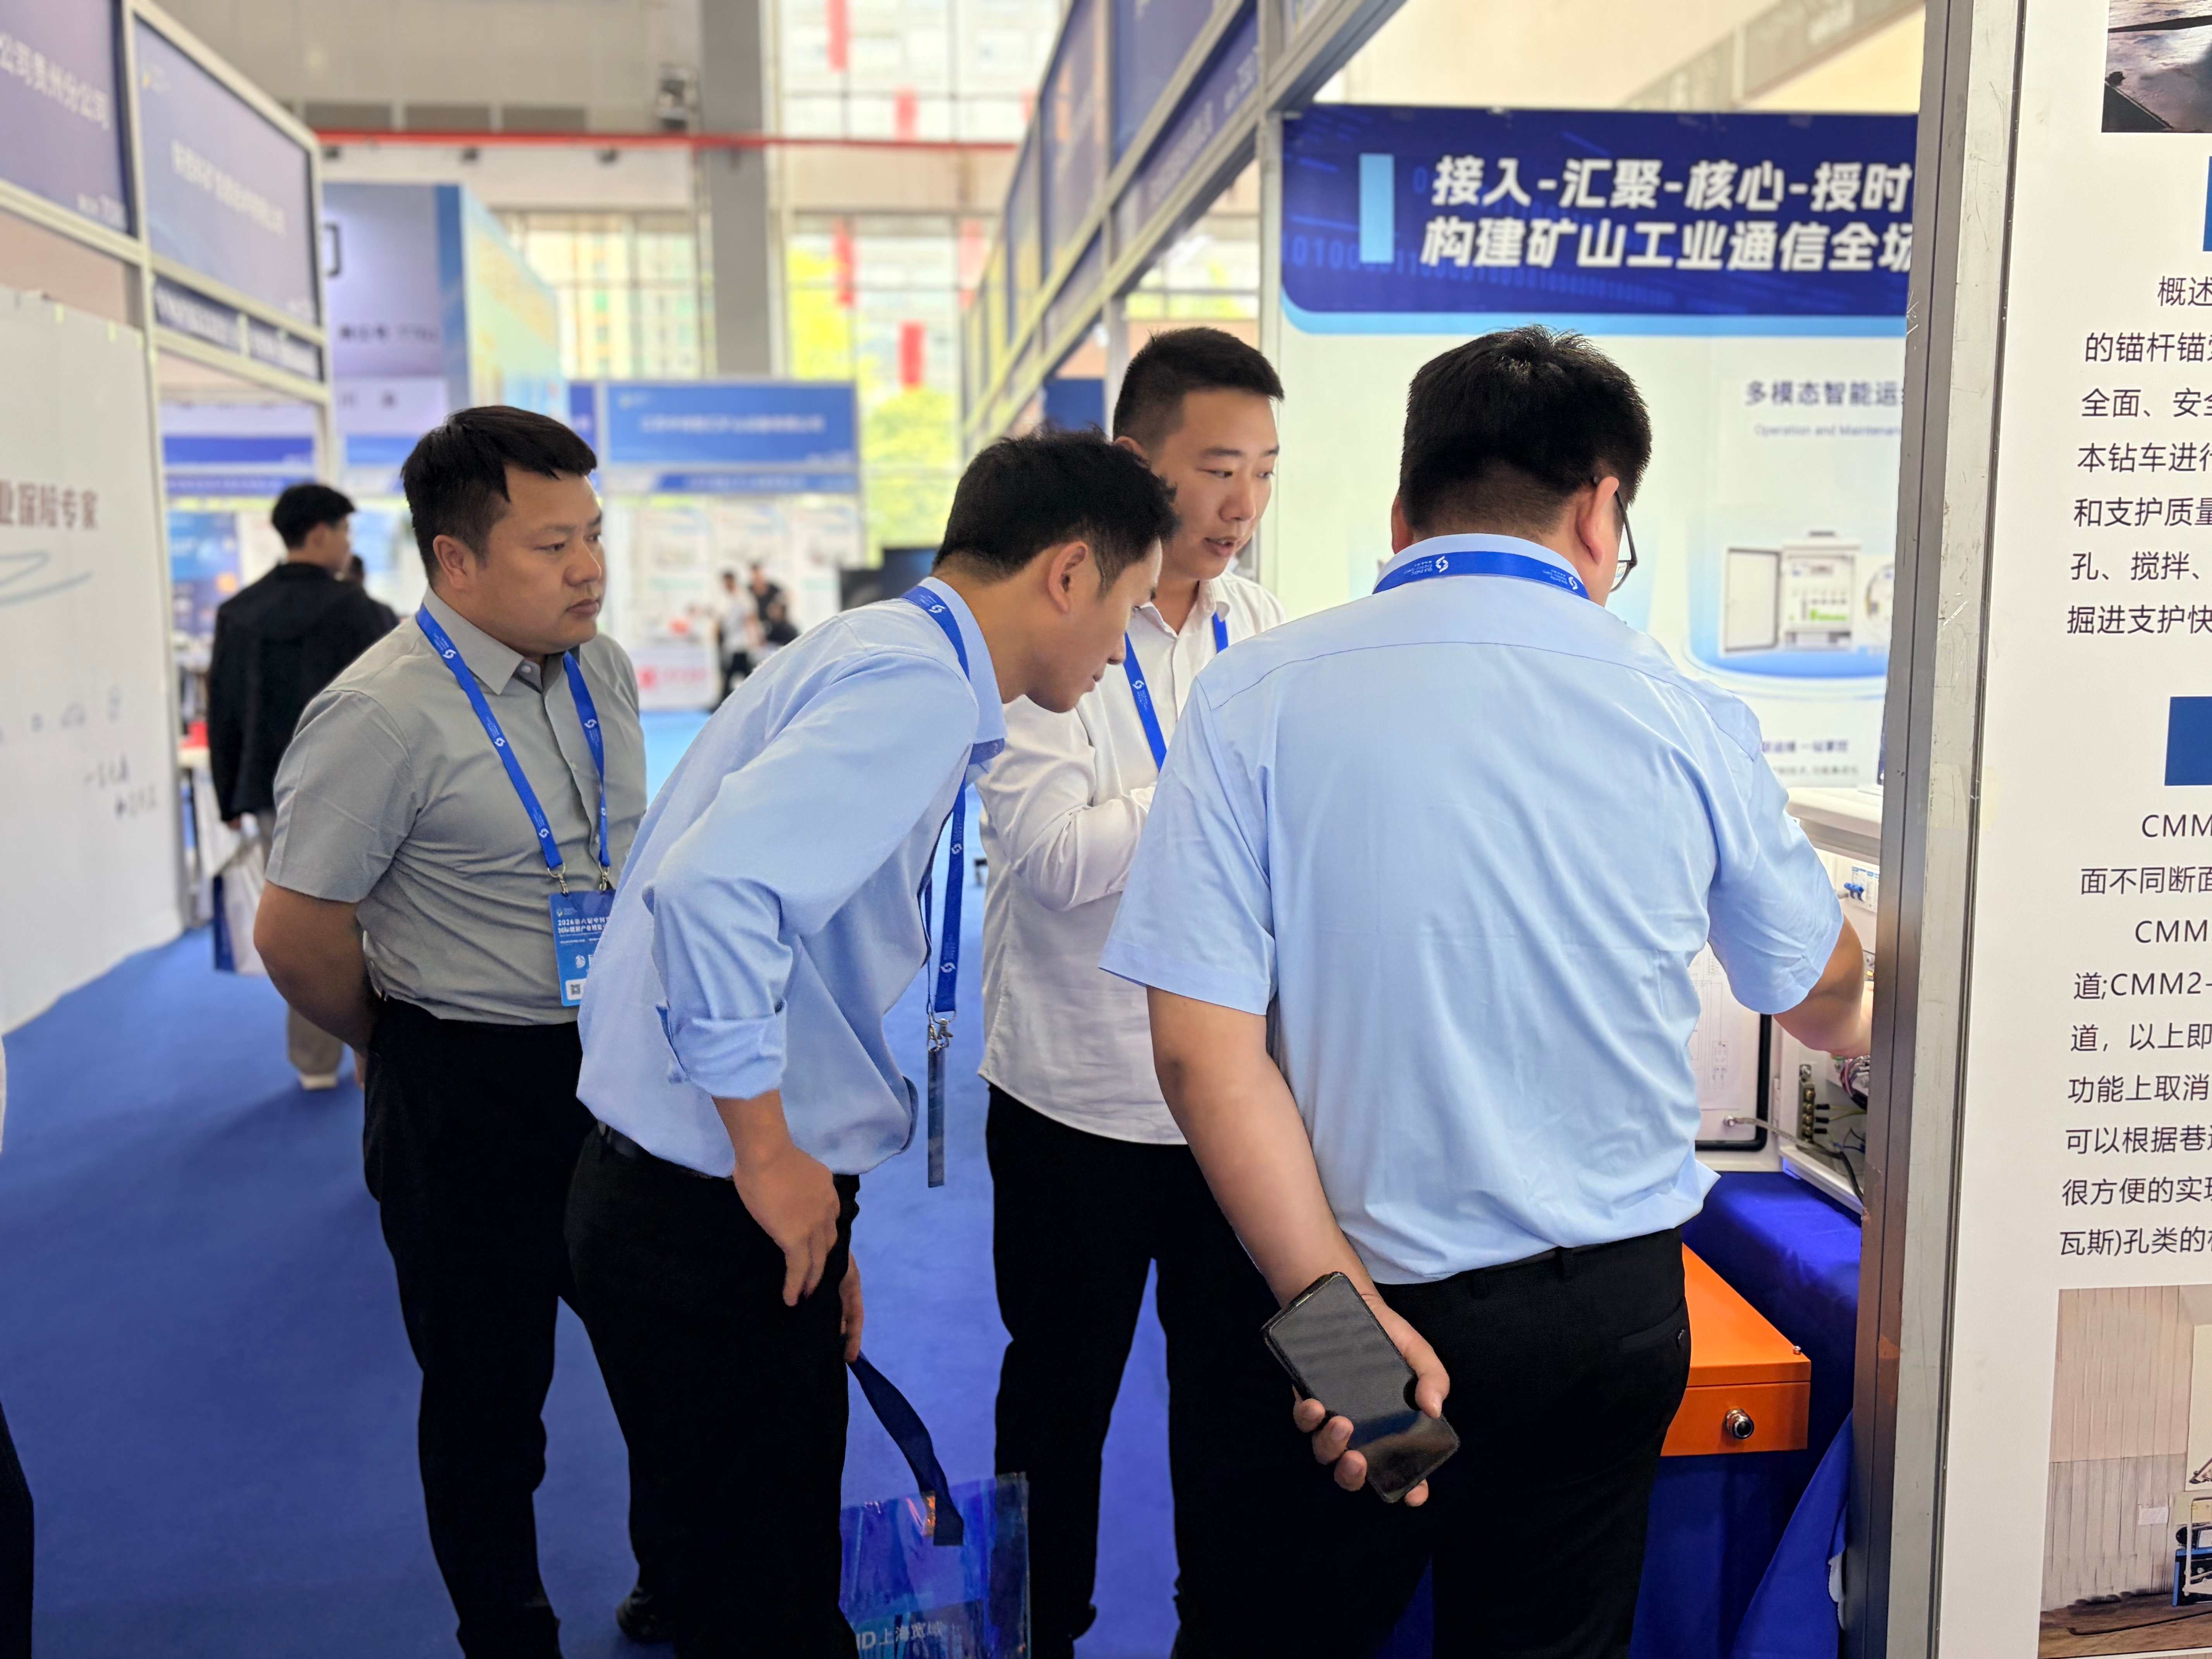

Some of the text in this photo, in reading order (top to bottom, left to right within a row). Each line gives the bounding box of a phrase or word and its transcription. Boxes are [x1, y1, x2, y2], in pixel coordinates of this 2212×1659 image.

[1432, 155, 1913, 212] 接入-汇聚-核心-授时
[2157, 275, 2212, 307] 概述
[2085, 331, 2212, 362] 的锚杆锚
[1746, 381, 1904, 406] 多模态智能运
[2073, 496, 2212, 527] 和支护质量
[2070, 551, 2200, 581] 孔、搅拌、
[2067, 604, 2212, 635] 掘进支护快
[2135, 919, 2212, 943] CMM
[2068, 1073, 2209, 1104] 功能上取消
[2065, 1124, 2212, 1154] 可以根据巷
[2059, 1226, 2212, 1257] 瓦斯)孔类的
